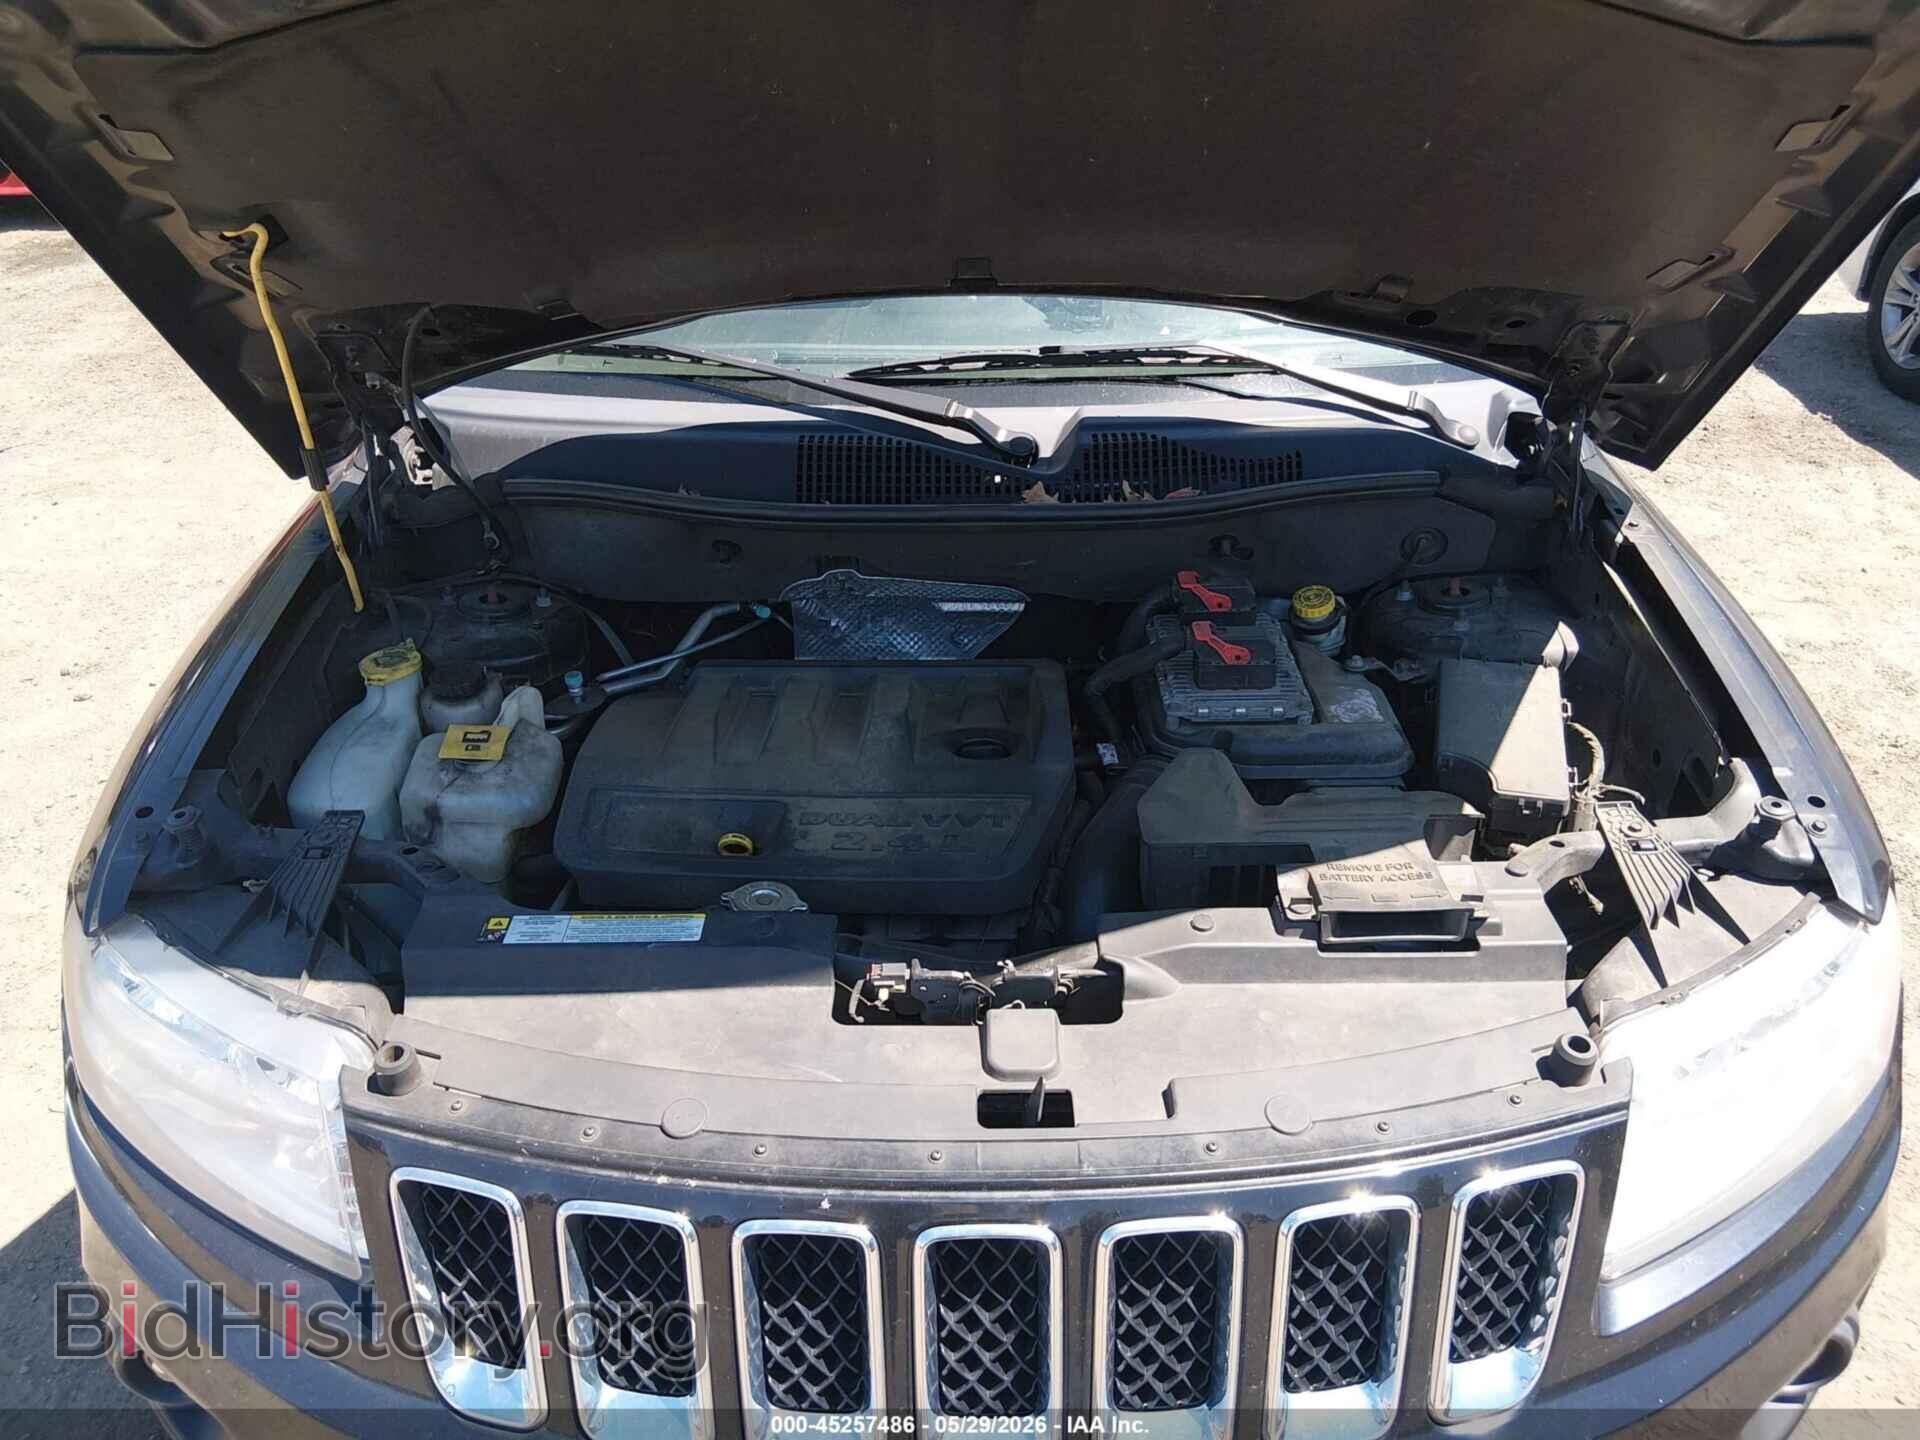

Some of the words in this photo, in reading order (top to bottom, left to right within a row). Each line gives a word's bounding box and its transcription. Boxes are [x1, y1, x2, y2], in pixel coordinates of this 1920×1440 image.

[799, 811, 911, 827] DUAL
[921, 812, 1013, 828] VVT
[1326, 862, 1383, 872] REMOVE
[1385, 861, 1414, 871] FOR
[1319, 872, 1376, 883] BATTERY
[1380, 871, 1434, 882] ACCESS
